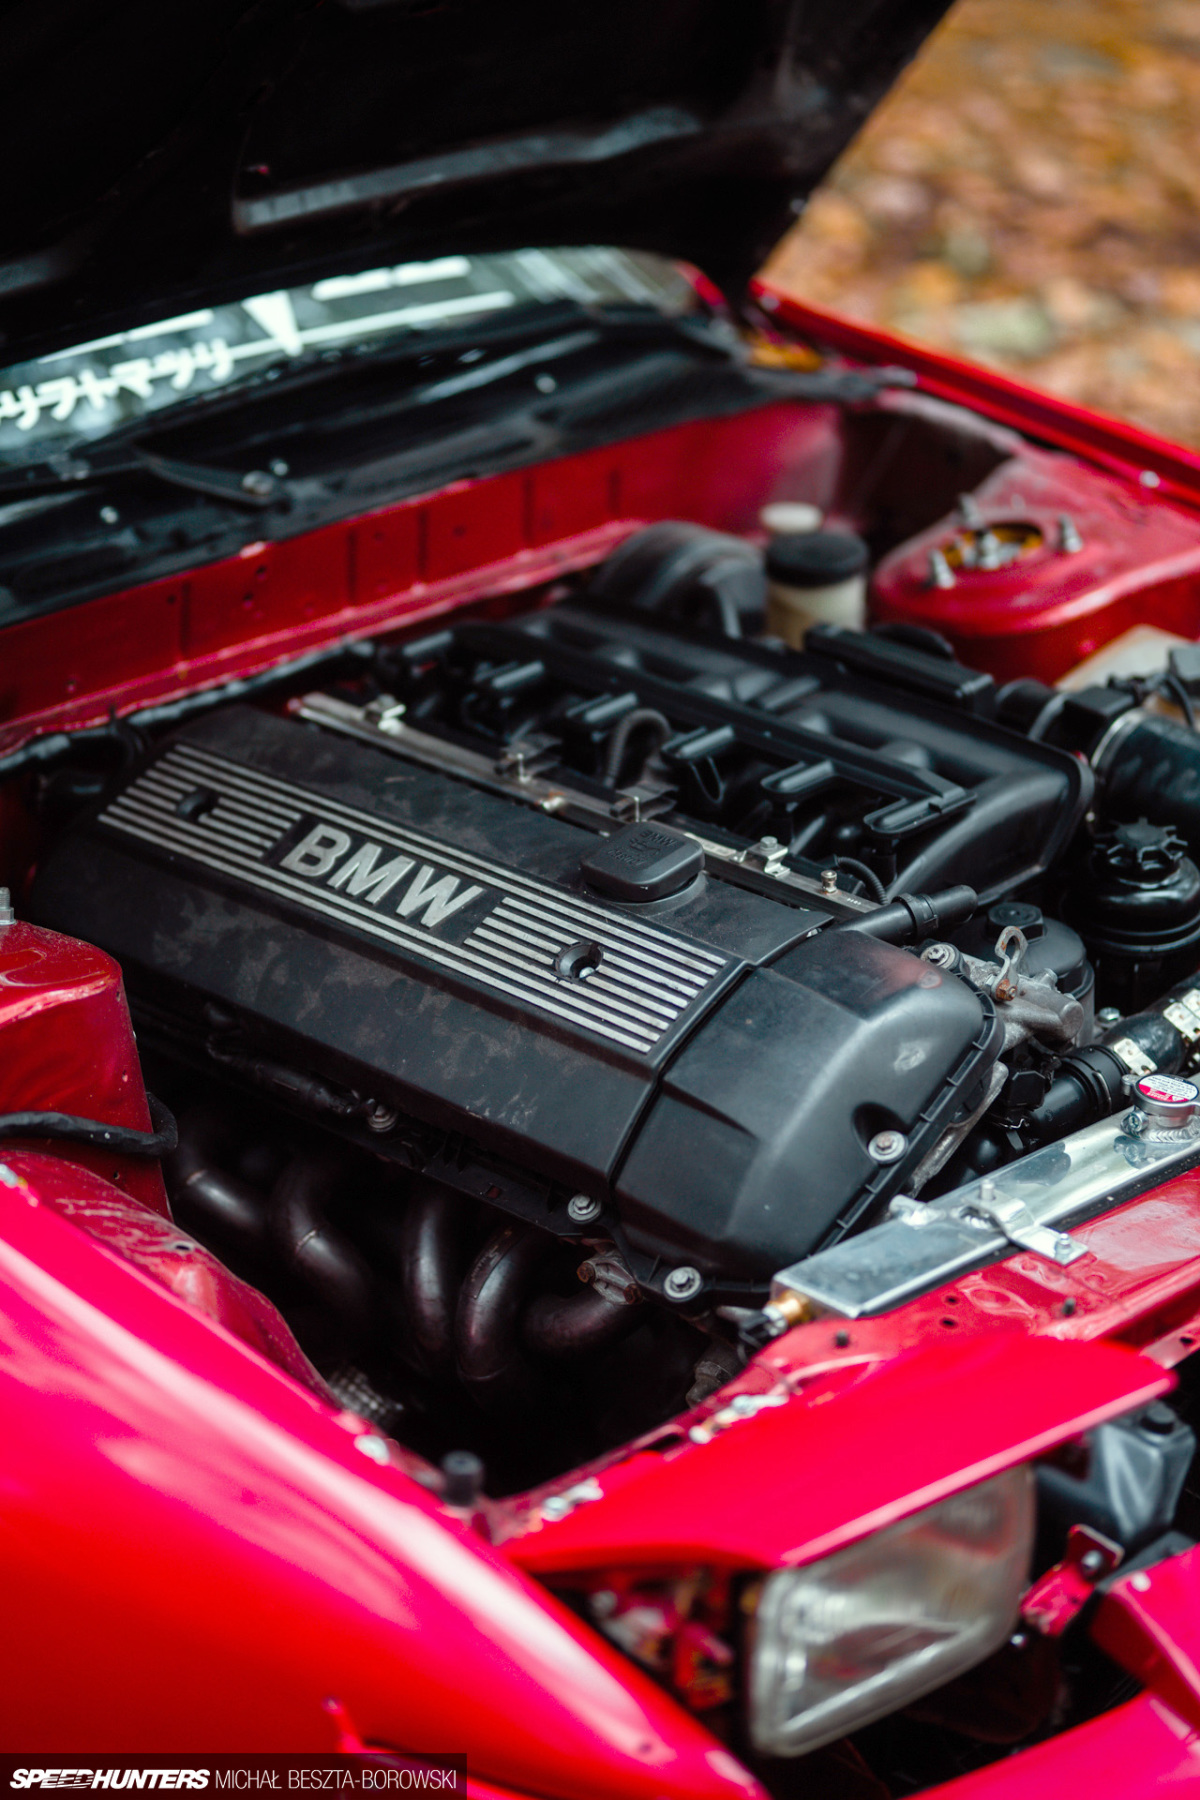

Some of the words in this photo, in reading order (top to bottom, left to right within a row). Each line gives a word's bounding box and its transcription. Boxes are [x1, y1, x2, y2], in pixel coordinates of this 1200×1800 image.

[0, 337, 234, 430] リフトマツリ
[279, 823, 485, 930] BMW
[640, 829, 678, 847] BMW
